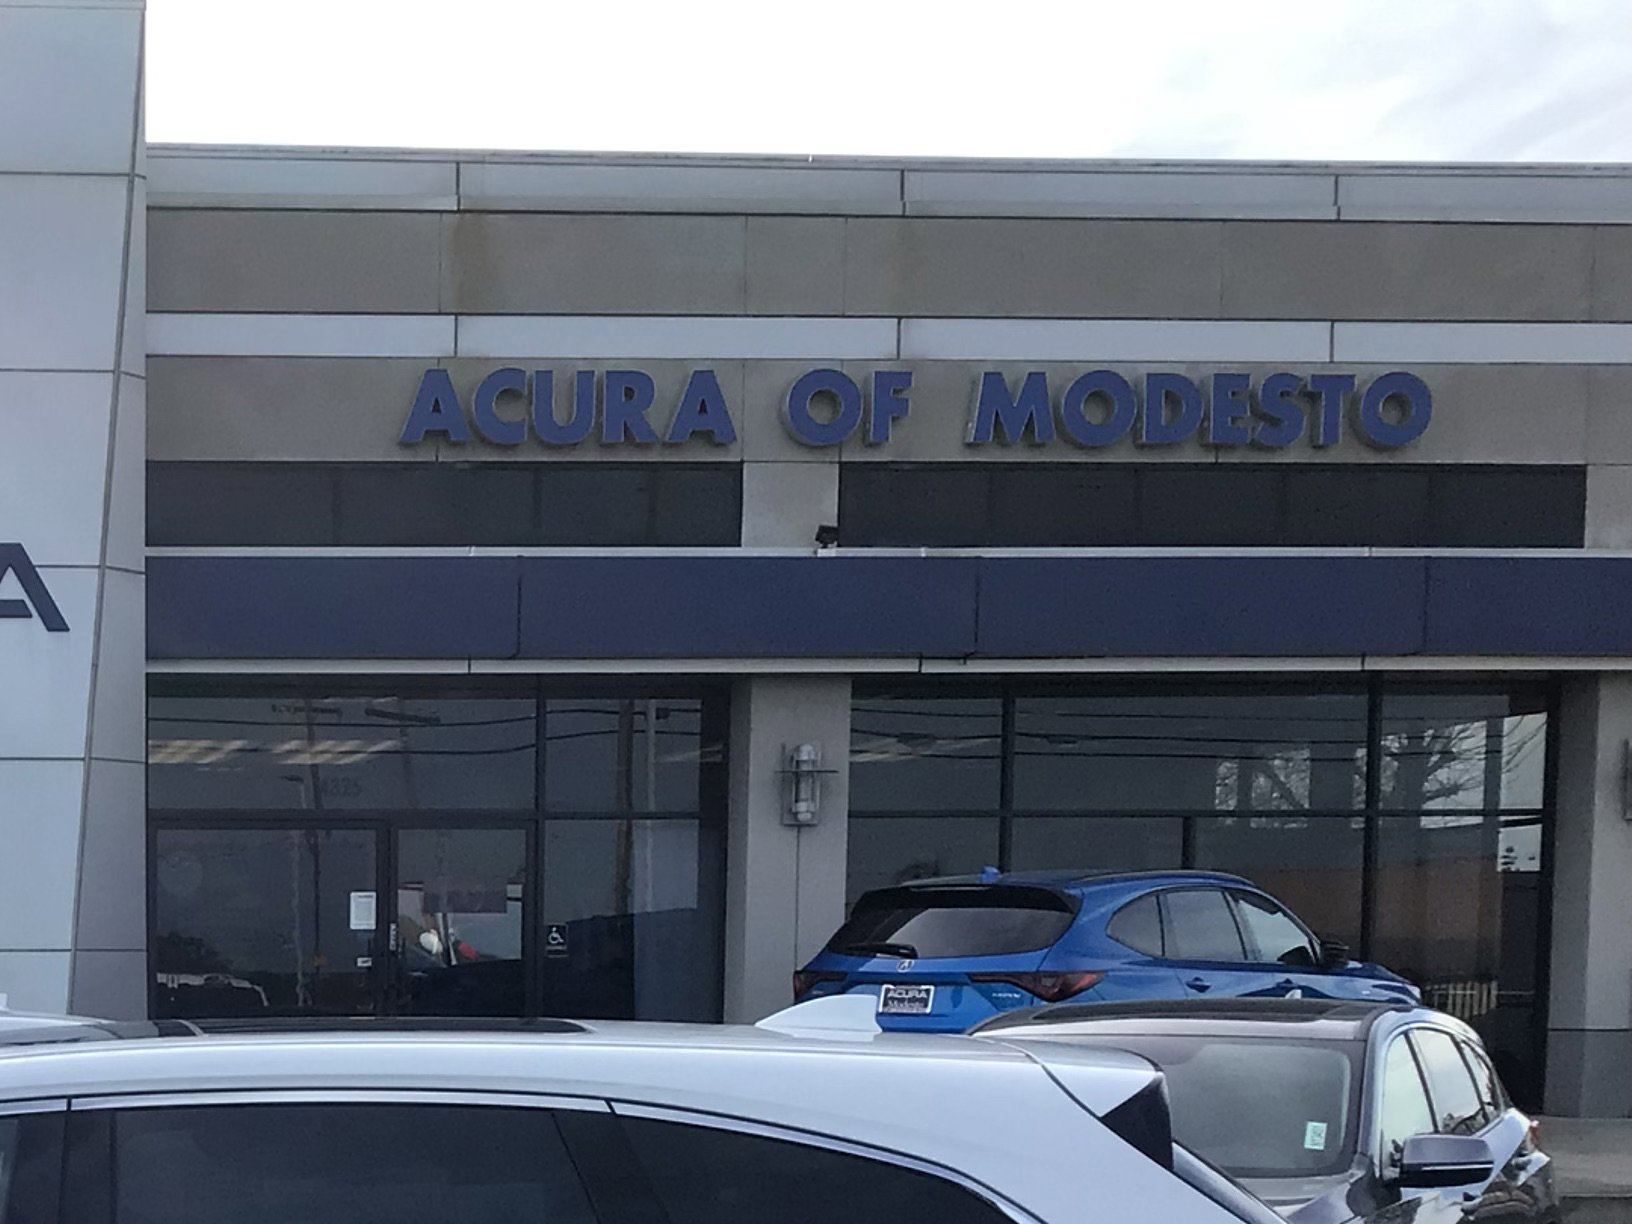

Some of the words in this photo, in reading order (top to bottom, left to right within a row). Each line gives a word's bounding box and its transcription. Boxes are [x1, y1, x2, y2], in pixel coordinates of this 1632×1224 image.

[399, 367, 738, 447] ACURA
[781, 367, 915, 448] OF
[965, 369, 1435, 451] MODESTO
[887, 989, 927, 998] ACURA
